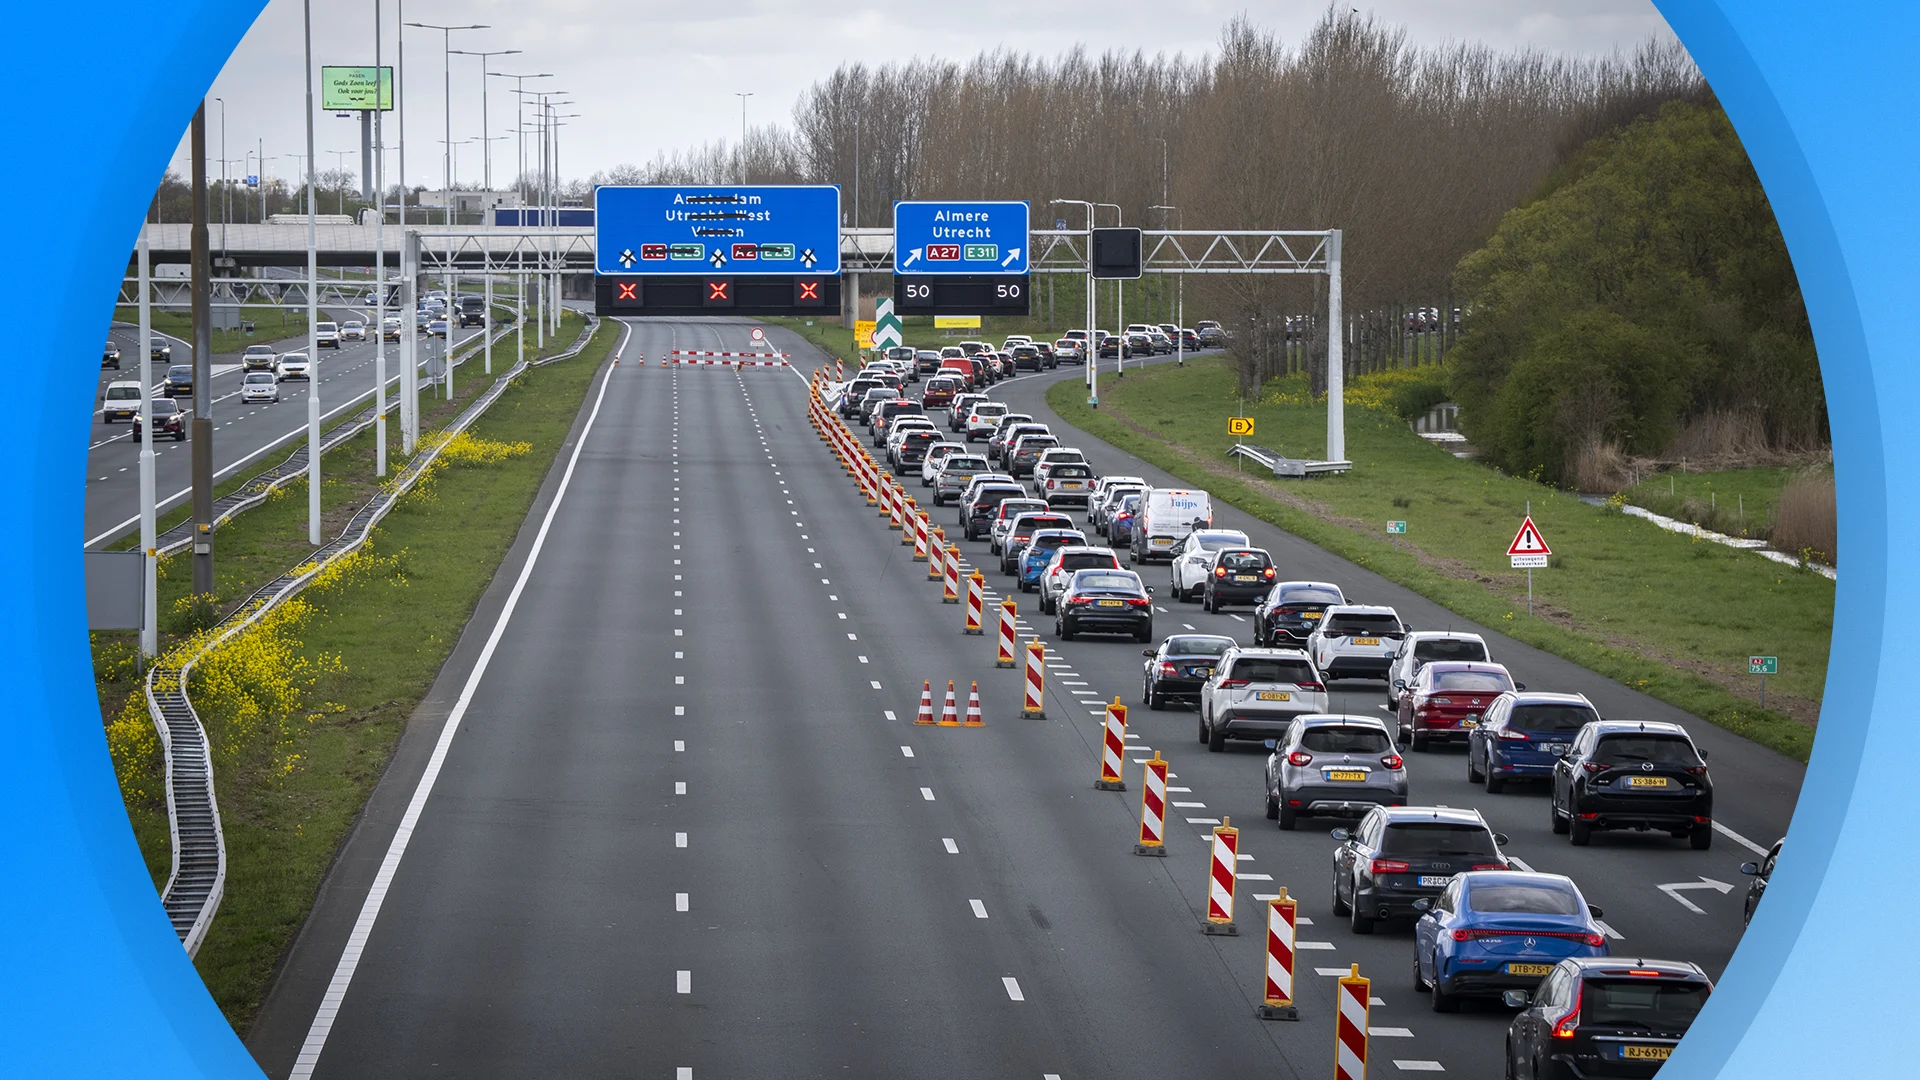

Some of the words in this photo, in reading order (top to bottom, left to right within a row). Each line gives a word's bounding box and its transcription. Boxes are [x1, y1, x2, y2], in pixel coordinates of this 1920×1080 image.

[934, 210, 989, 222] Almere
[932, 226, 991, 238] Utrecht
[906, 284, 930, 298] 50
[997, 284, 1020, 298] 50
[1235, 421, 1243, 431] B
[1333, 772, 1362, 780] H-771-TX
[1512, 965, 1550, 974] JTB-75-T
